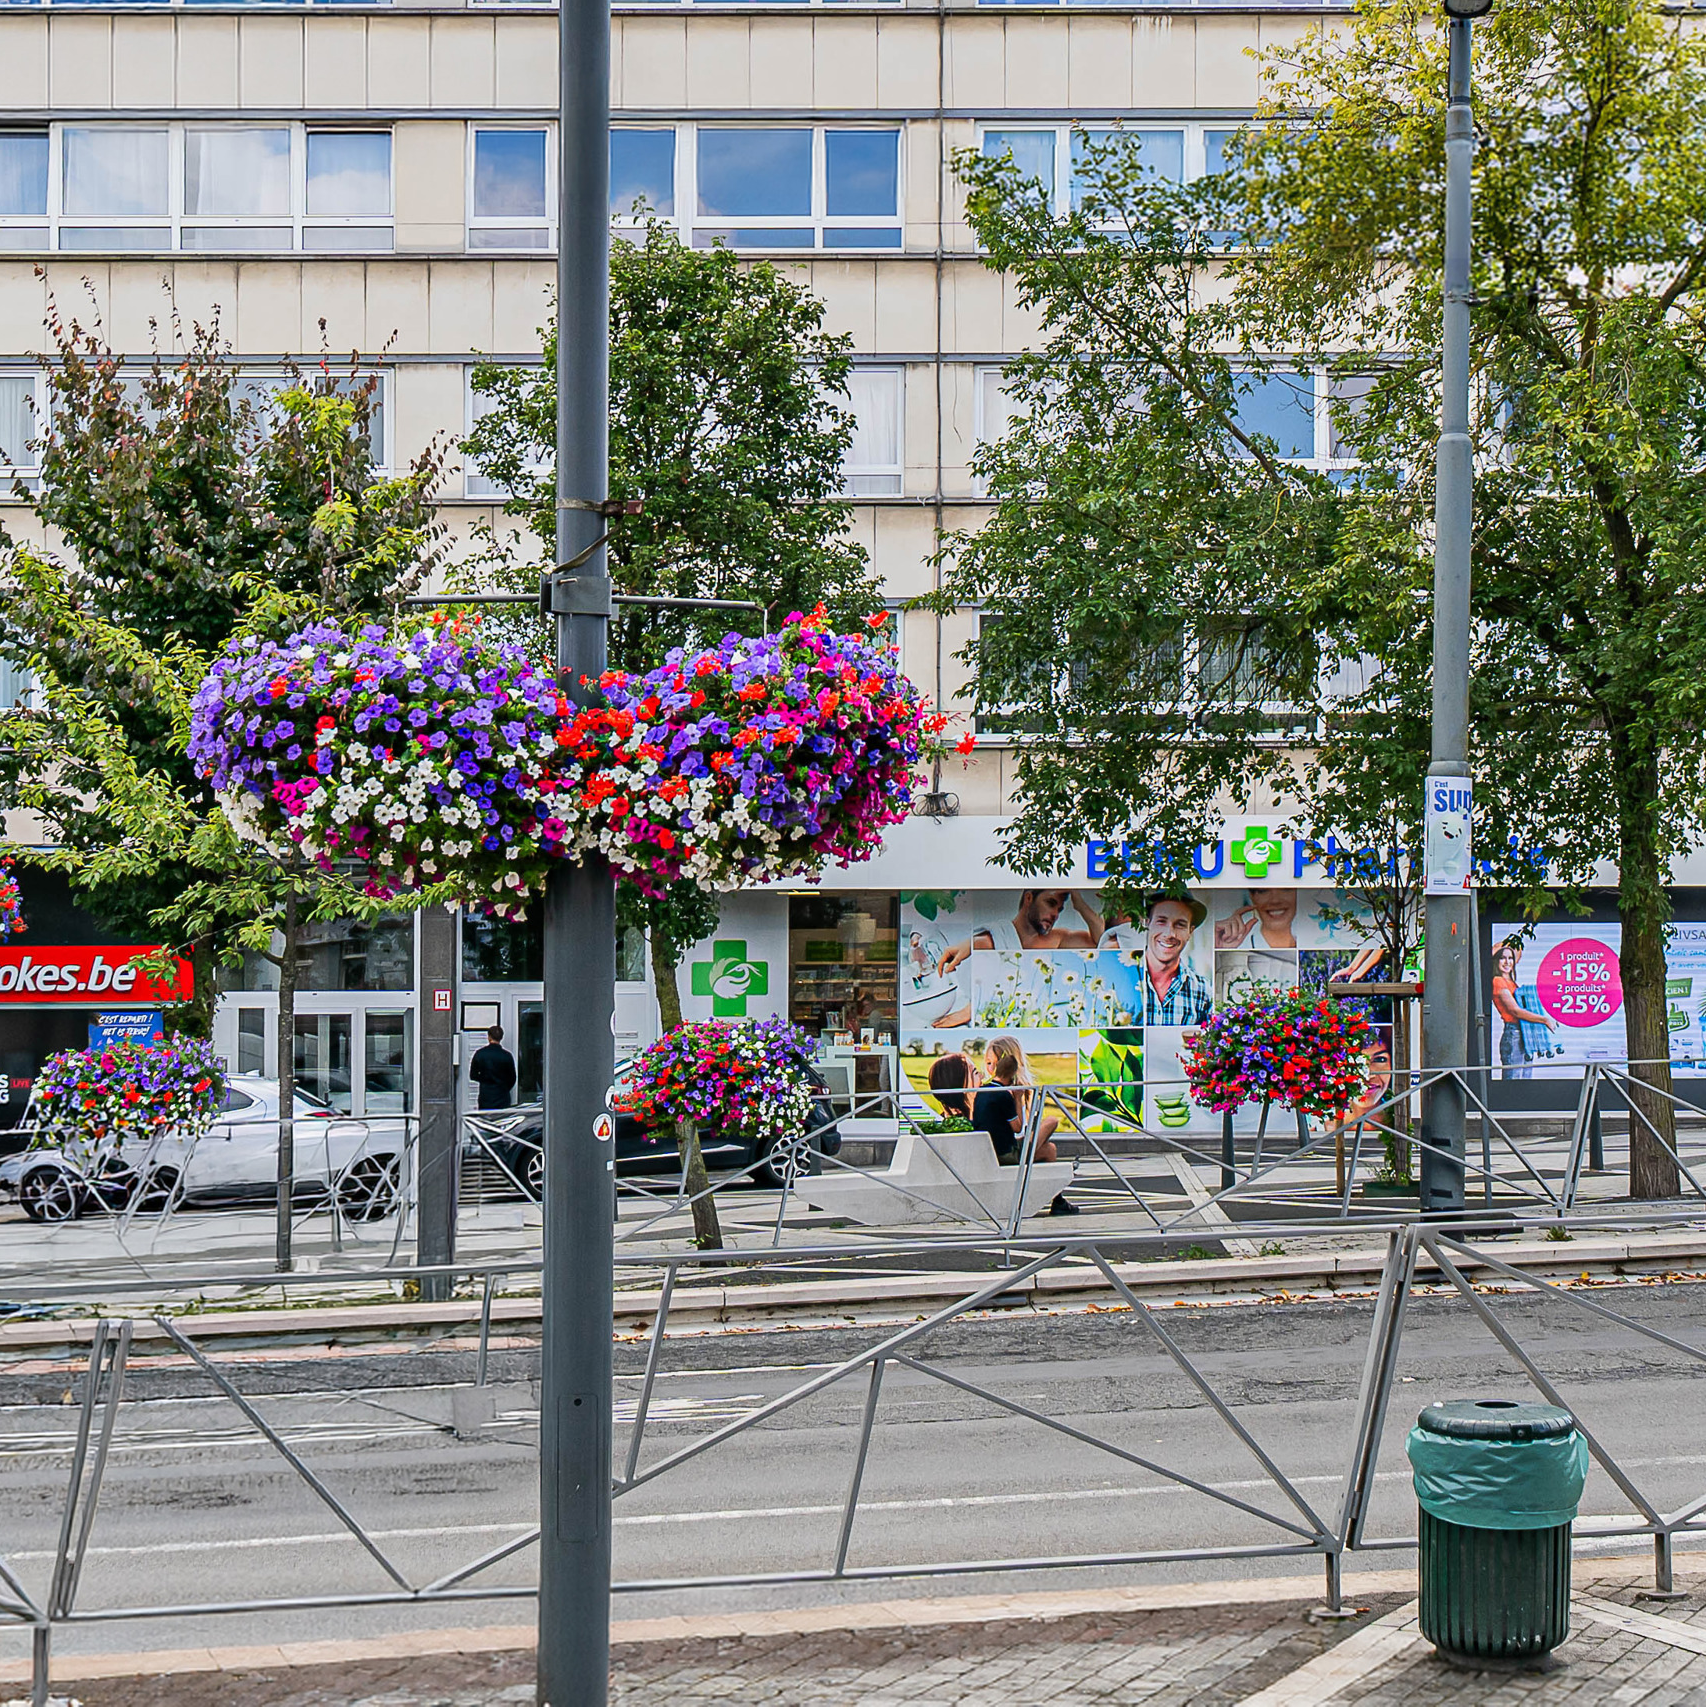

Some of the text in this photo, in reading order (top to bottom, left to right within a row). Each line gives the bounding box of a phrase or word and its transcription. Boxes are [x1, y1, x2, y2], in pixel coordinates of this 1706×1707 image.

[1552, 963, 1610, 981] -15%
[438, 994, 448, 1007] H
[1552, 994, 1610, 1014] -25%
